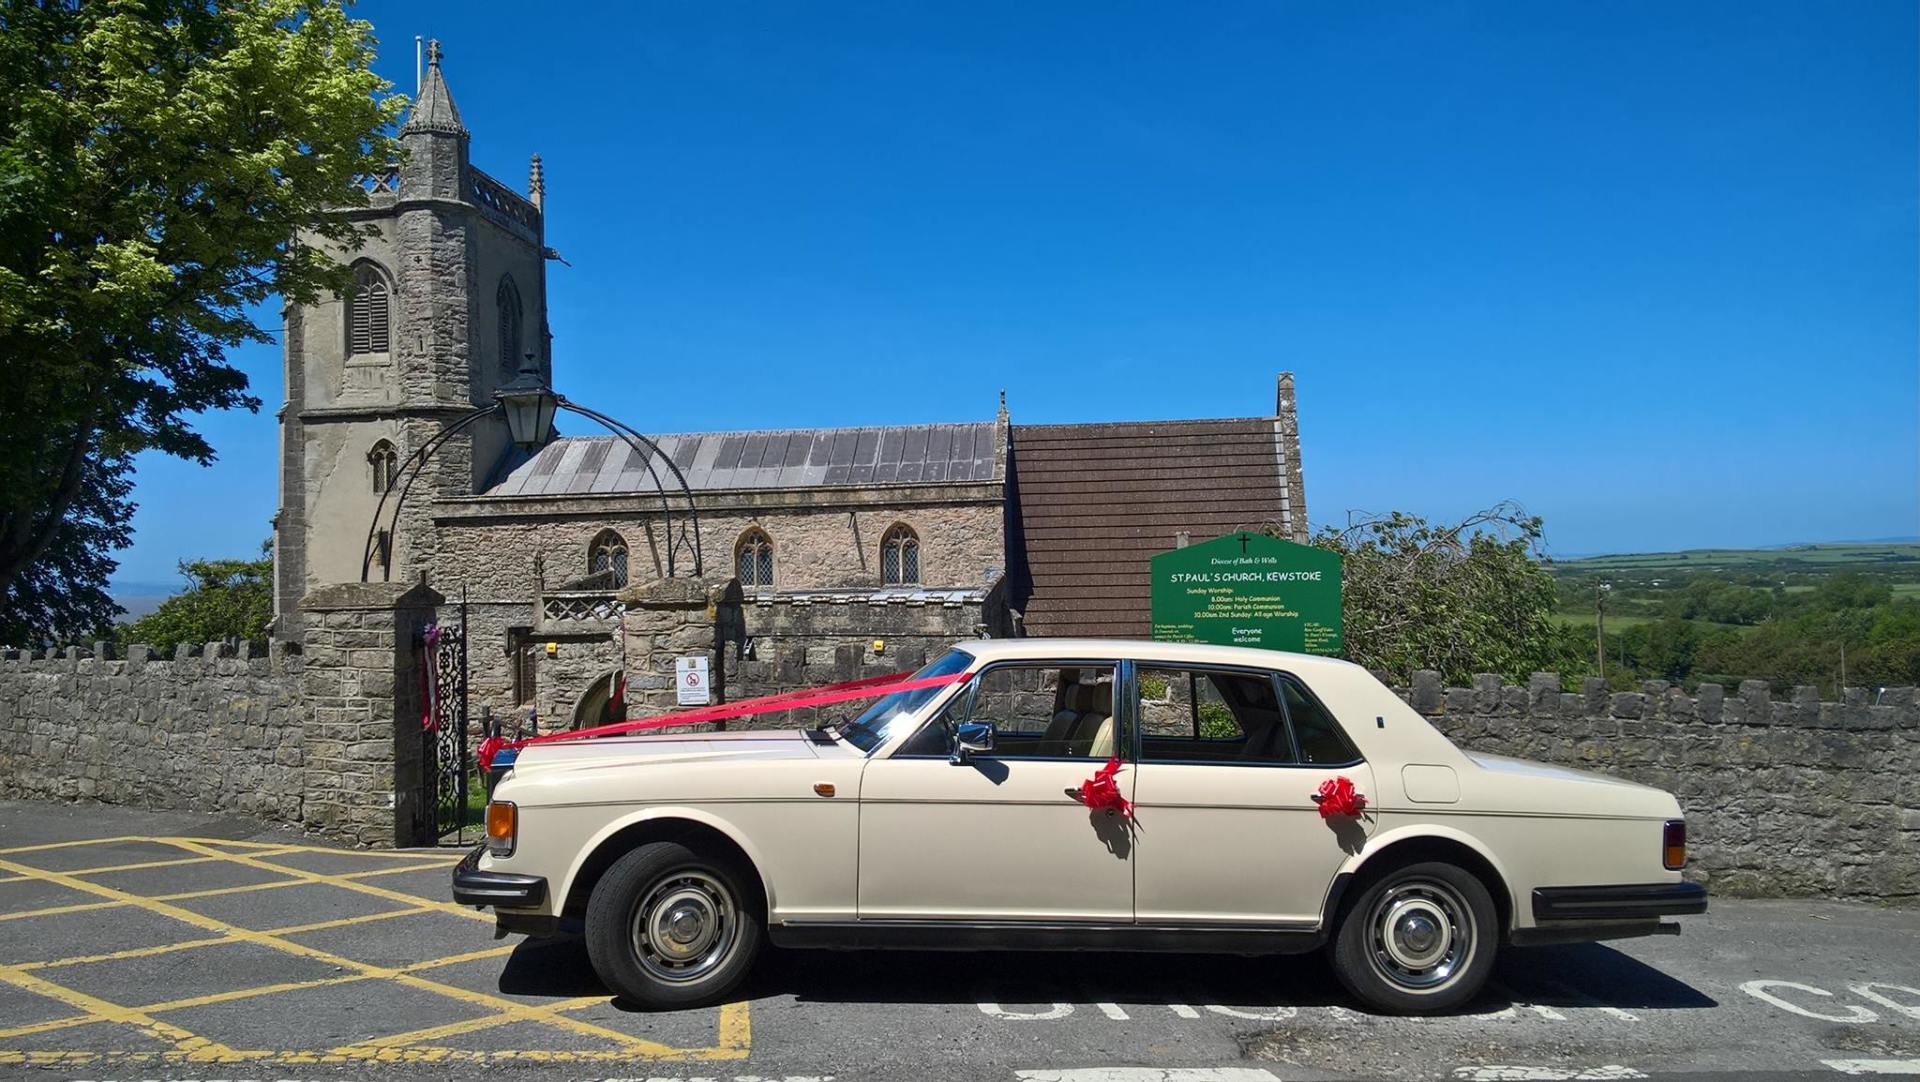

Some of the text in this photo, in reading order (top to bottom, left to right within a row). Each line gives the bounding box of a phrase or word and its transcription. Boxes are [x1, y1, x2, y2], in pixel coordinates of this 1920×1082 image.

[1232, 557, 1239, 565] of
[1222, 572, 1265, 582] CHURCH,
[1266, 571, 1322, 581] KEWSTOKE
[1231, 627, 1262, 636] Everyone
